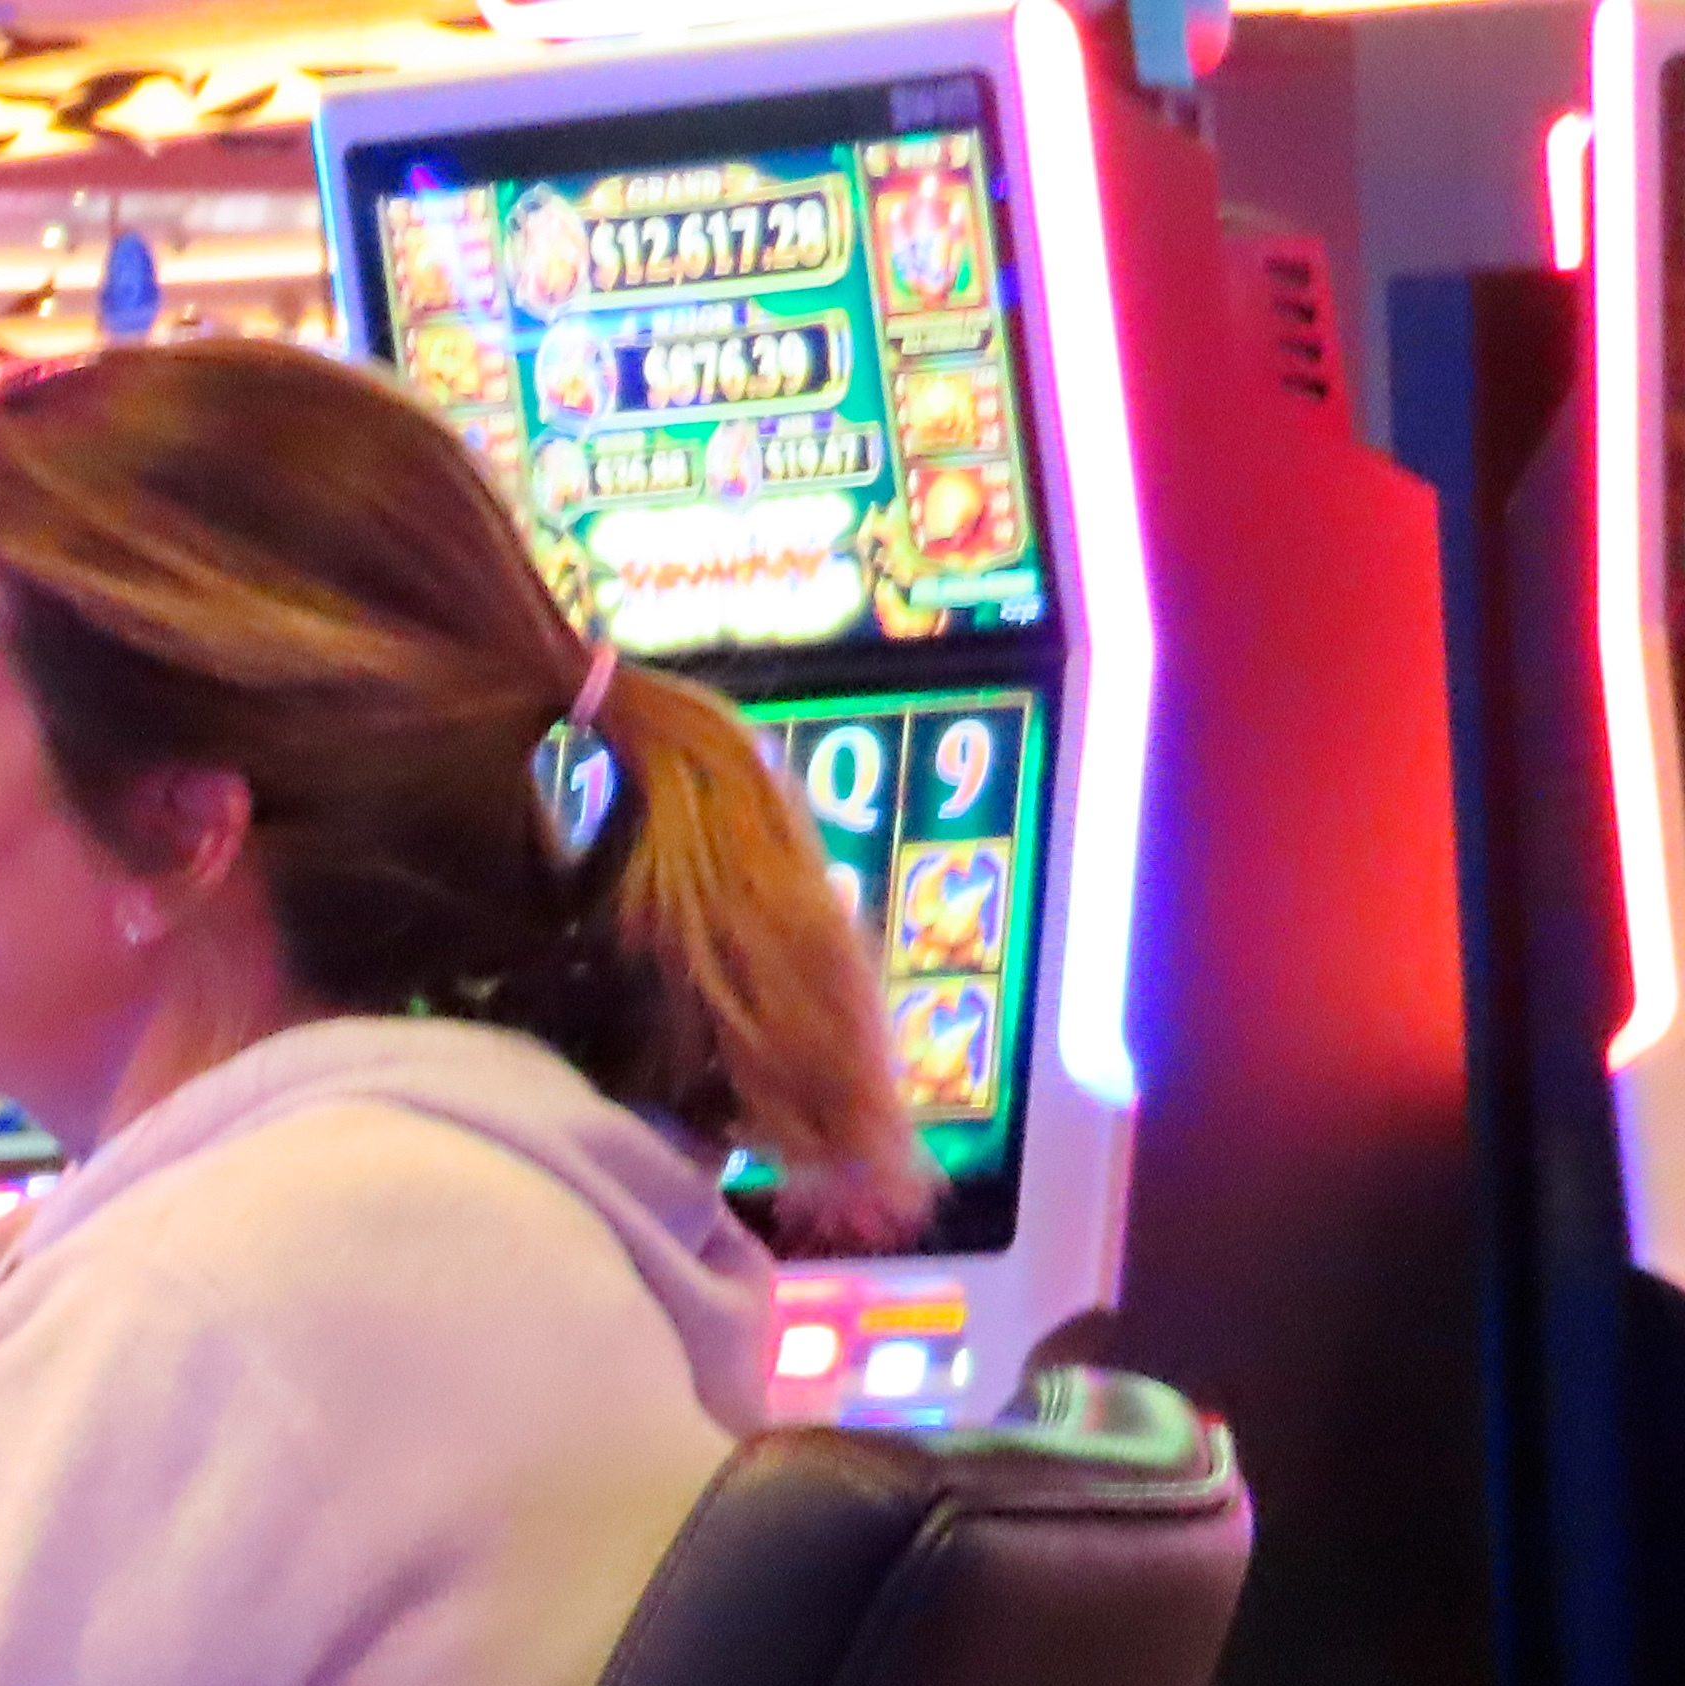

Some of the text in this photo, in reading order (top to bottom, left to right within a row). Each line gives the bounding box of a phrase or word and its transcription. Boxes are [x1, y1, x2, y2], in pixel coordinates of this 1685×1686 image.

[589, 199, 828, 292] $12,617.28
[806, 717, 992, 833] Q 9
